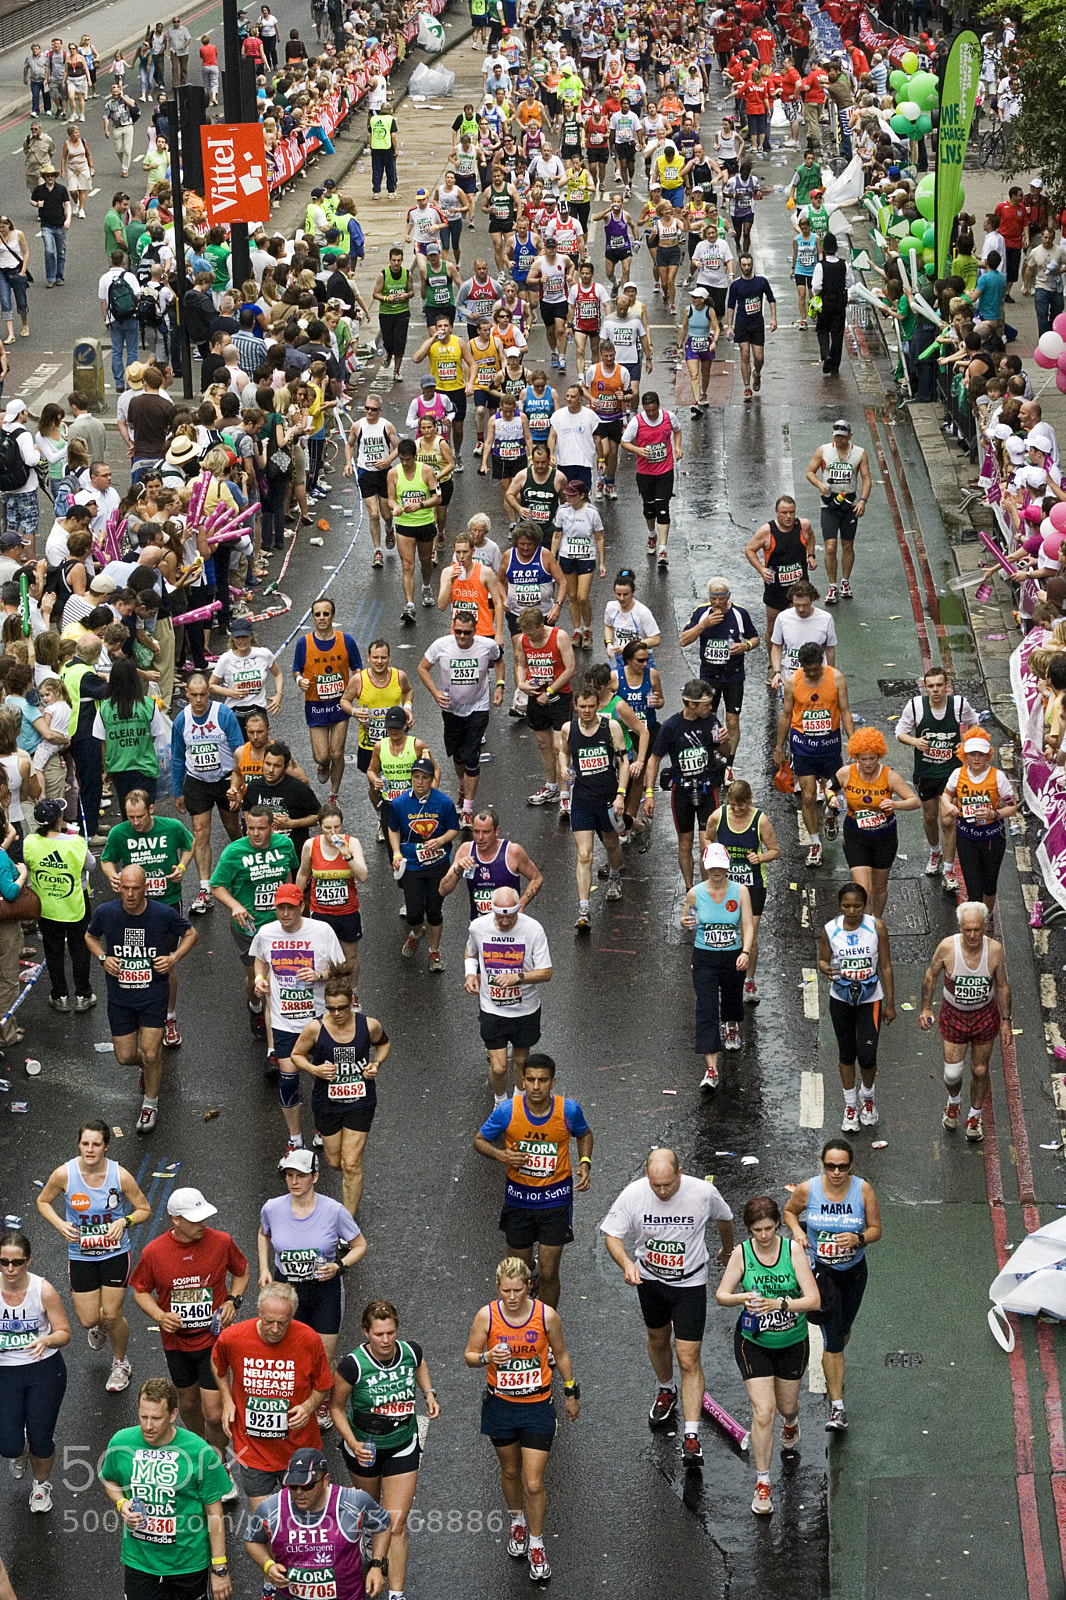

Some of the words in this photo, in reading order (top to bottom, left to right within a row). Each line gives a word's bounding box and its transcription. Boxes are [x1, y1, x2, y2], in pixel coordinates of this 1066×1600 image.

[941, 103, 960, 125] WE
[208, 138, 238, 215] Vittel
[473, 288, 493, 299] ITALIA
[501, 424, 523, 432] Sparks
[364, 437, 384, 446] KEVIN
[779, 563, 801, 572] FLORA
[512, 569, 539, 578] T.R.O.T.
[453, 588, 479, 598] Oasis
[515, 584, 540, 592] FLORA
[453, 600, 478, 610] FLORA
[706, 639, 728, 648] FLORA
[233, 656, 258, 669] CAT
[314, 655, 343, 664] MARK
[451, 659, 478, 668] FLORA
[528, 659, 553, 667] FLORA
[233, 671, 261, 682] FLORA
[316, 674, 343, 683] FLORA
[453, 668, 475, 678] 2337
[318, 683, 345, 693] 45709
[627, 692, 643, 701] ZOE
[311, 706, 324, 714] Run
[803, 709, 831, 719] FLORA
[190, 721, 217, 734] TIM
[804, 719, 832, 730] 45389
[109, 728, 136, 740] CLEAR
[192, 733, 222, 741] Kirkwood
[926, 732, 957, 740] PSP
[119, 737, 140, 748] CREW
[808, 735, 819, 746] for
[191, 743, 217, 754] FLORA
[579, 747, 607, 757] FLORA
[679, 747, 707, 758] FLORA
[194, 754, 217, 765] 4193
[580, 757, 607, 769] 36281
[388, 780, 413, 790] LORA
[962, 795, 991, 804] FLORA
[127, 835, 168, 850] DAVE
[241, 848, 286, 868] NEAL
[39, 859, 68, 869] adidas
[38, 872, 68, 885] FLORA
[726, 873, 752, 885] 4964
[257, 892, 276, 904] 197
[315, 887, 347, 900] 24570
[271, 940, 312, 950] CRISPY
[839, 946, 871, 956] CHEWE
[119, 959, 150, 970] FLORA
[840, 958, 872, 969] FLORA
[955, 976, 989, 986] FLORA
[280, 989, 312, 1000] FLORA
[489, 985, 521, 998] 38776
[281, 1000, 313, 1012] 38886
[329, 1084, 364, 1097] 38652
[524, 1131, 548, 1140] JAY
[518, 1140, 557, 1153] FLORA
[527, 1156, 556, 1169] 5514
[507, 1184, 523, 1199] Run
[526, 1188, 541, 1200] for
[545, 1185, 571, 1199] Sense
[71, 1199, 91, 1207] Kids
[820, 1203, 853, 1215] MARIA
[643, 1213, 695, 1225] Hamers
[80, 1225, 108, 1236] FLOR
[646, 1239, 685, 1253] FLORA
[280, 1249, 318, 1262] FLORA
[646, 1252, 684, 1267] 49634
[172, 1276, 200, 1286] SOSPAN
[753, 1273, 791, 1285] WENDY
[3, 1308, 26, 1320] ALI
[172, 1302, 212, 1319] 25460
[0, 1332, 38, 1347] FLORA
[507, 1344, 537, 1355] AURA
[243, 1357, 295, 1370] MOTOR
[243, 1368, 295, 1380] NEURONE
[366, 1365, 414, 1387] MARIE
[243, 1377, 295, 1390] DISEASE
[369, 1380, 405, 1394] NSPCC
[243, 1387, 294, 1397] ASSOCIATION
[376, 1388, 415, 1406] FLORA
[246, 1397, 287, 1411] FLORA
[249, 1412, 282, 1429] 9231
[142, 1450, 173, 1461] RUSS
[131, 1460, 179, 1485] MS
[288, 1528, 329, 1544] PETE
[286, 1543, 304, 1553] CLIC
[305, 1543, 334, 1554] Sargent
[287, 1568, 334, 1584] FLORA
[290, 1583, 336, 1599] 37705
